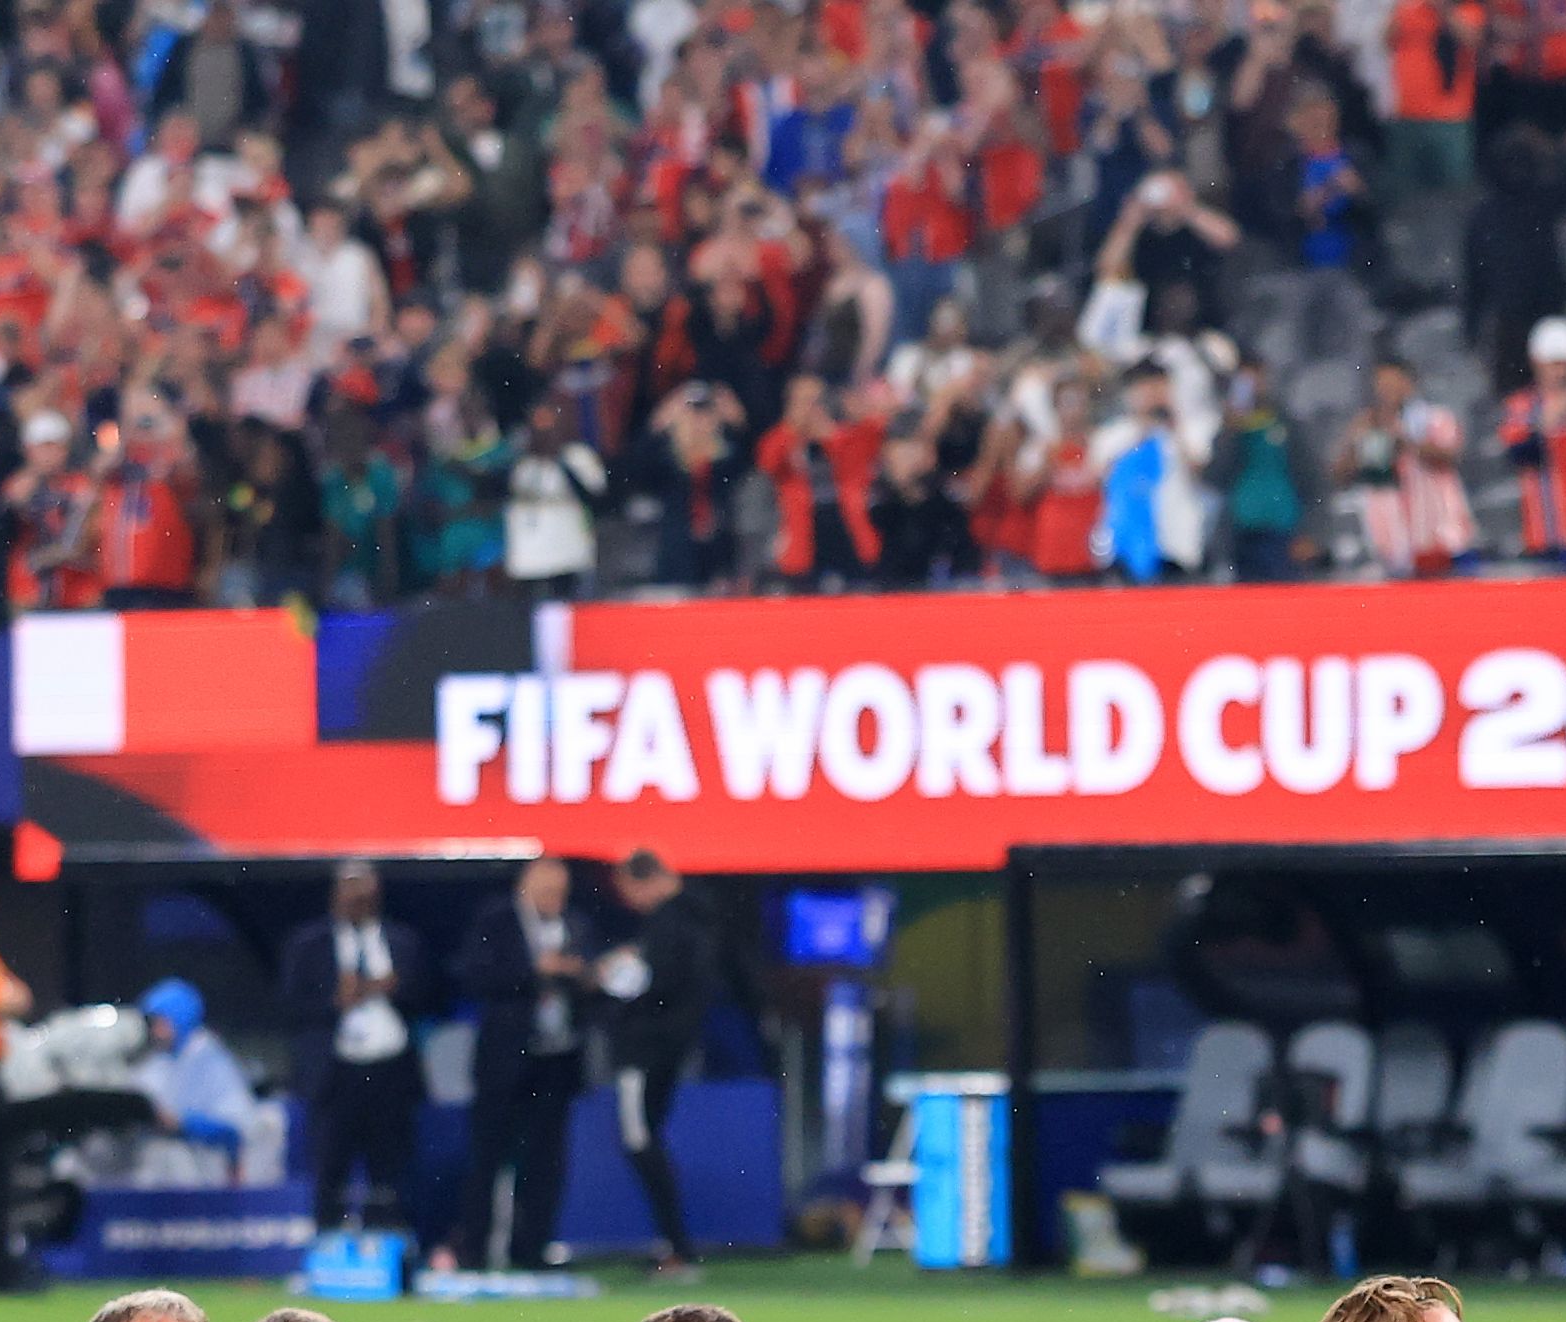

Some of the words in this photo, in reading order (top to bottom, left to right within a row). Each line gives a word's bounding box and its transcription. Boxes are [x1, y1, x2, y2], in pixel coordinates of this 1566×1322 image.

[437, 671, 700, 804] FIFA
[705, 657, 1166, 801] WORLD
[1176, 653, 1446, 796] CUP
